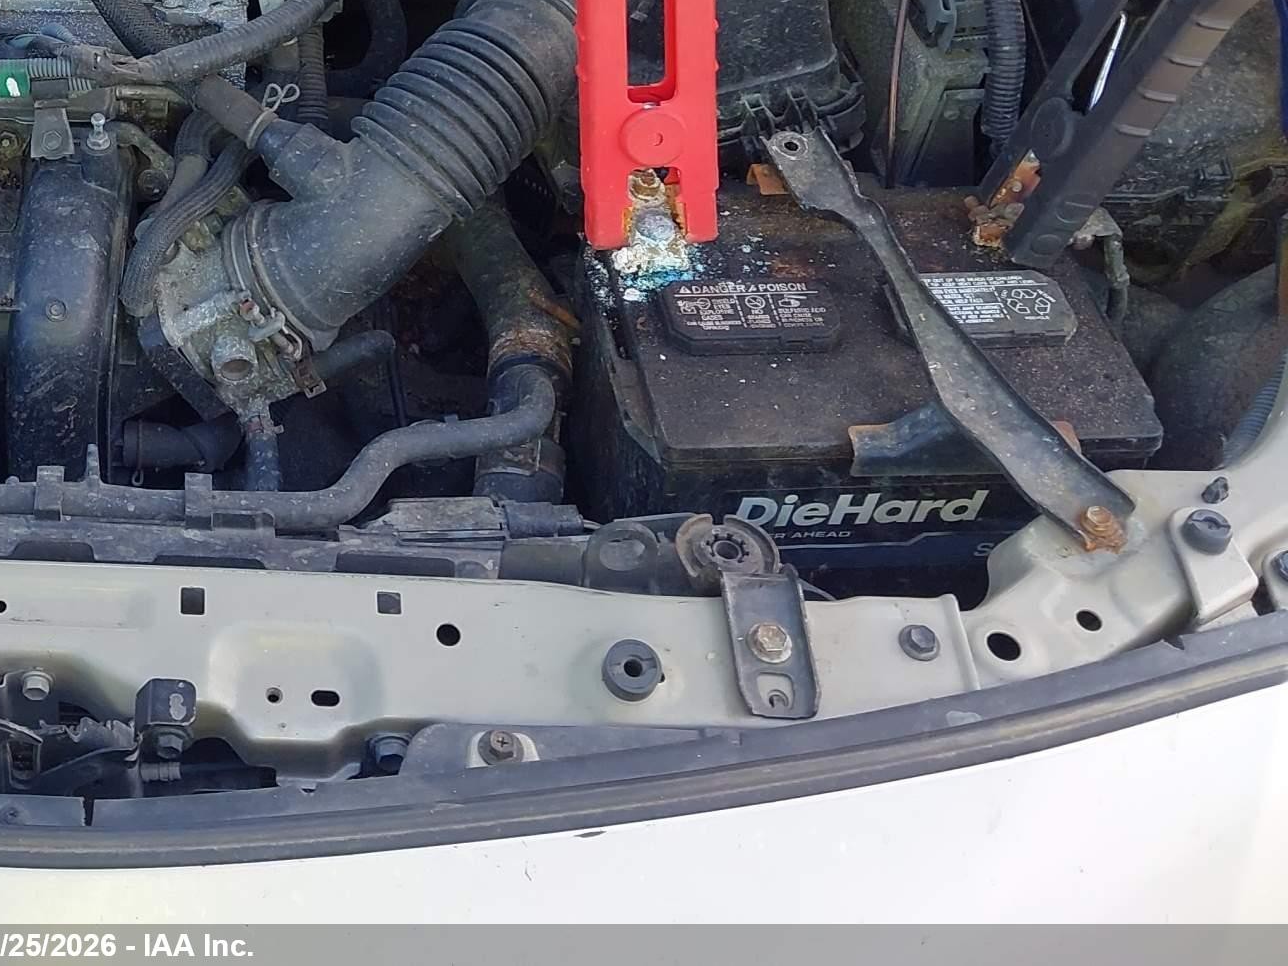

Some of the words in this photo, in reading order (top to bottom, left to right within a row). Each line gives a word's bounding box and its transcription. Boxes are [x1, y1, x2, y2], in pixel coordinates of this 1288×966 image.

[692, 283, 746, 294] DANGER
[758, 282, 807, 292] POISON
[735, 490, 989, 527] DieHard
